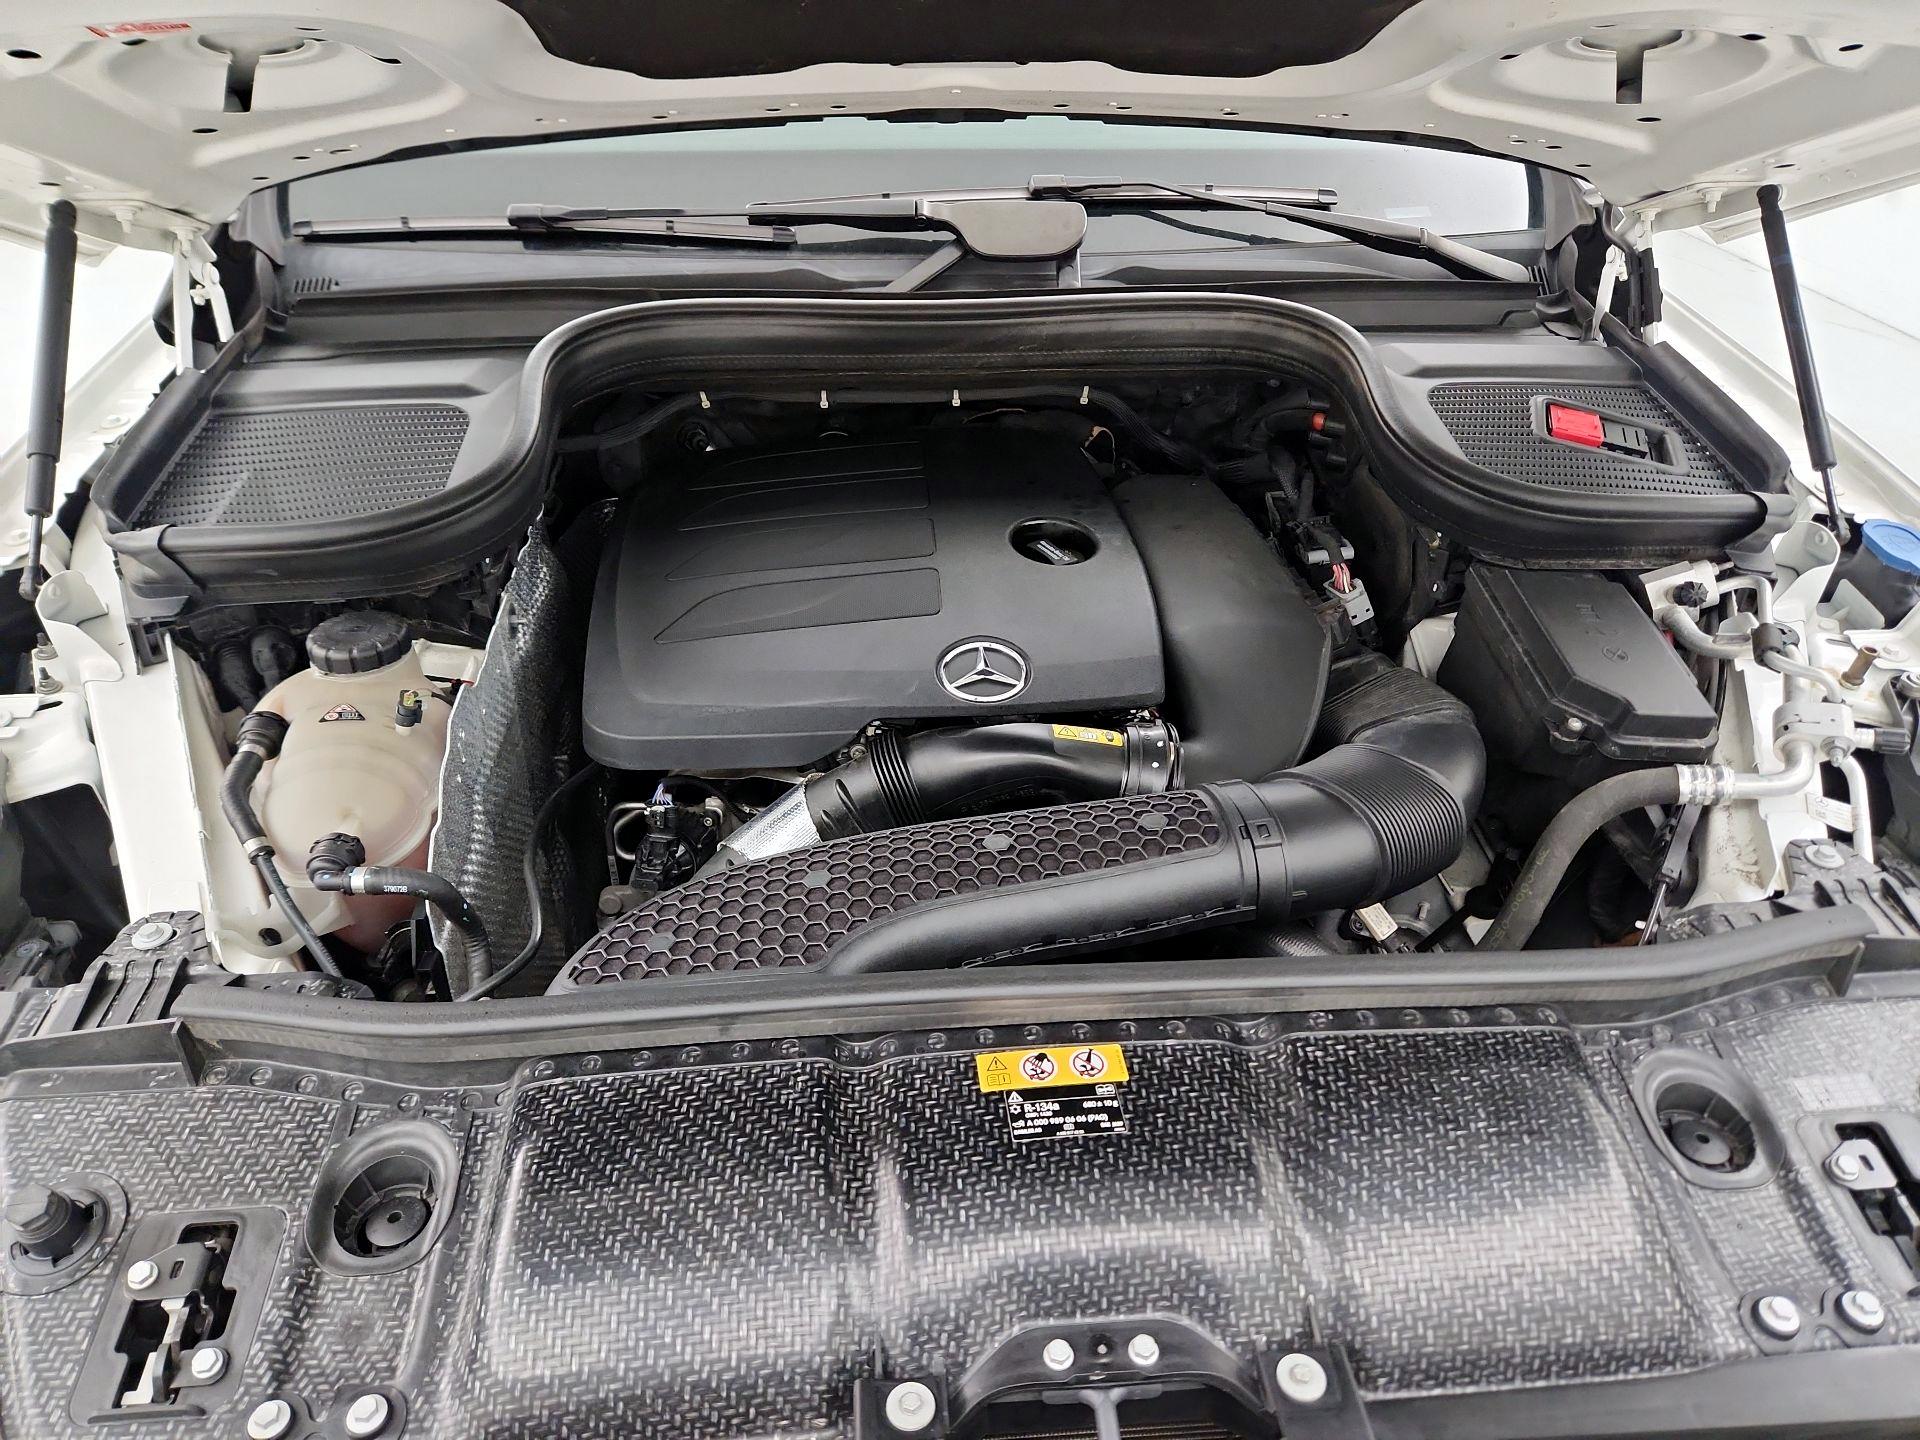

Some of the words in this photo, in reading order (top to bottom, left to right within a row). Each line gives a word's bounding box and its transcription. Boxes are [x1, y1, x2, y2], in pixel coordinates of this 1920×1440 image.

[1023, 1102, 1060, 1113] R-134a
[1026, 1119, 1034, 1127] A
[1033, 1118, 1049, 1127] 000
